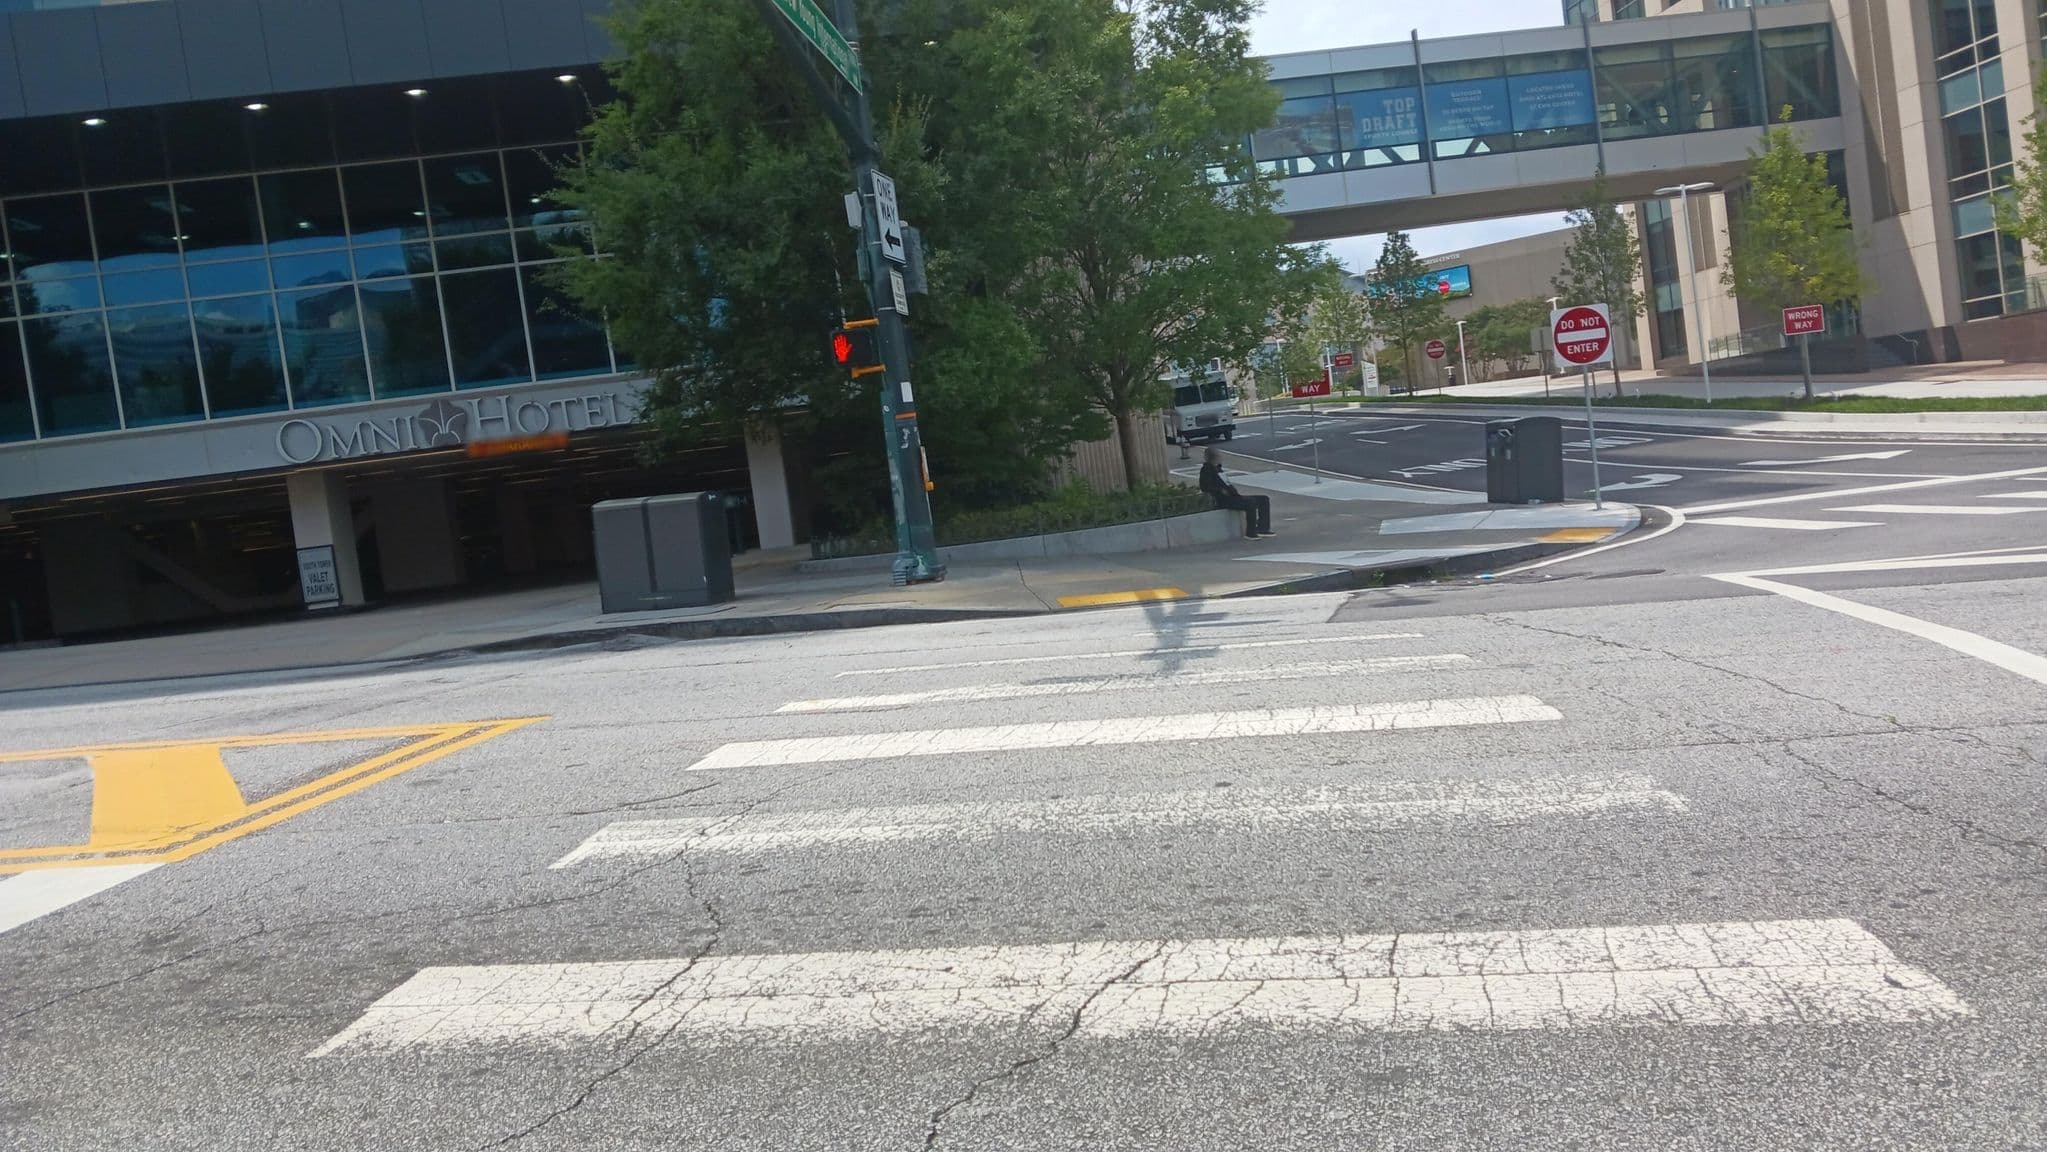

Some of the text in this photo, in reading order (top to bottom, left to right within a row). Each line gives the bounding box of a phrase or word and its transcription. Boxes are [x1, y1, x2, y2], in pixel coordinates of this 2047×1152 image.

[1383, 97, 1416, 115] TOP
[1362, 112, 1417, 134] DRAFT
[876, 178, 894, 202] ONE
[880, 200, 896, 224] WAY
[1787, 309, 1819, 321] WRONG
[1560, 316, 1600, 330] DO NOT
[1794, 320, 1814, 330] WAY
[1567, 341, 1600, 355] ENTER
[1301, 384, 1321, 394] WAY
[276, 415, 420, 464] OMNI
[467, 392, 635, 435] HOTEL
[309, 571, 328, 583] VALET
[306, 582, 335, 596] PARKING
